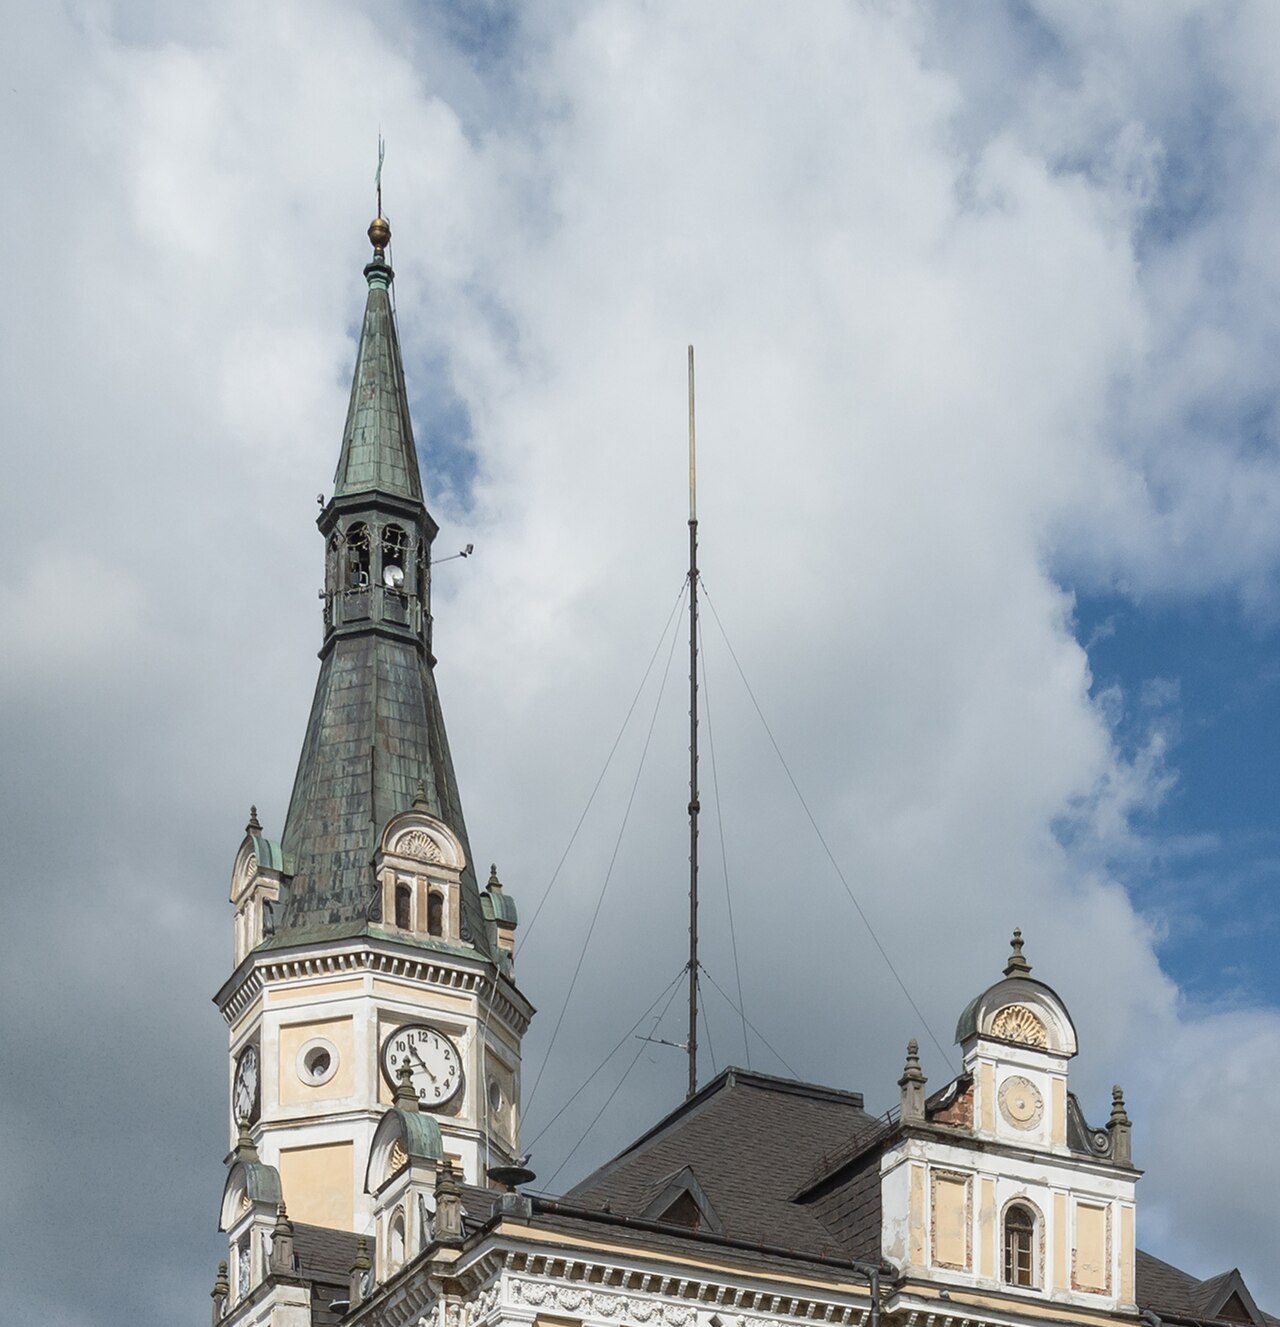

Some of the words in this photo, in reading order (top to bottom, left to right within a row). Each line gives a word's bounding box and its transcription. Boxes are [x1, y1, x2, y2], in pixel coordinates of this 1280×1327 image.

[407, 1034, 415, 1045] 11
[418, 1031, 428, 1043] 12
[396, 1041, 406, 1052] 10
[434, 1038, 439, 1050] 1
[391, 1055, 397, 1065] 9
[444, 1049, 451, 1060] 2
[449, 1065, 455, 1075] 3
[443, 1078, 450, 1090] 4
[420, 1088, 426, 1098] 6
[435, 1086, 441, 1097] 5
